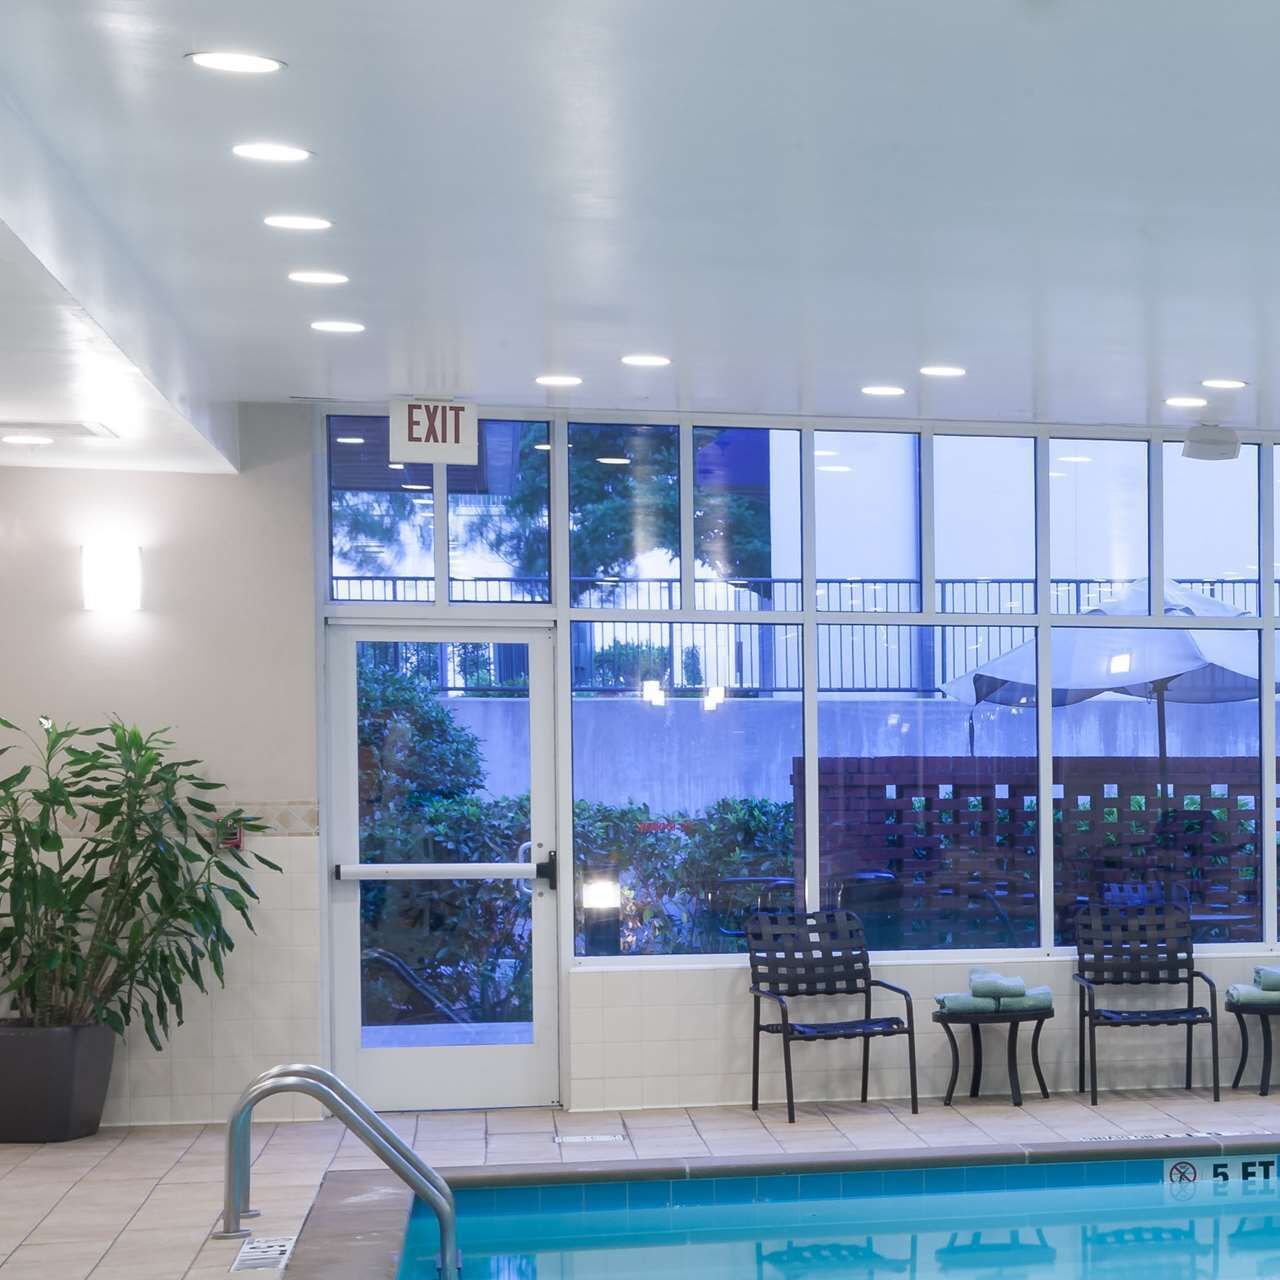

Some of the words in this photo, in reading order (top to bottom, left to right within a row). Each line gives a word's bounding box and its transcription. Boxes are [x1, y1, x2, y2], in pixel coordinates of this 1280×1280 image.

[407, 404, 465, 444] EXIT
[1213, 1163, 1229, 1182] 5
[1242, 1160, 1275, 1181] FT
